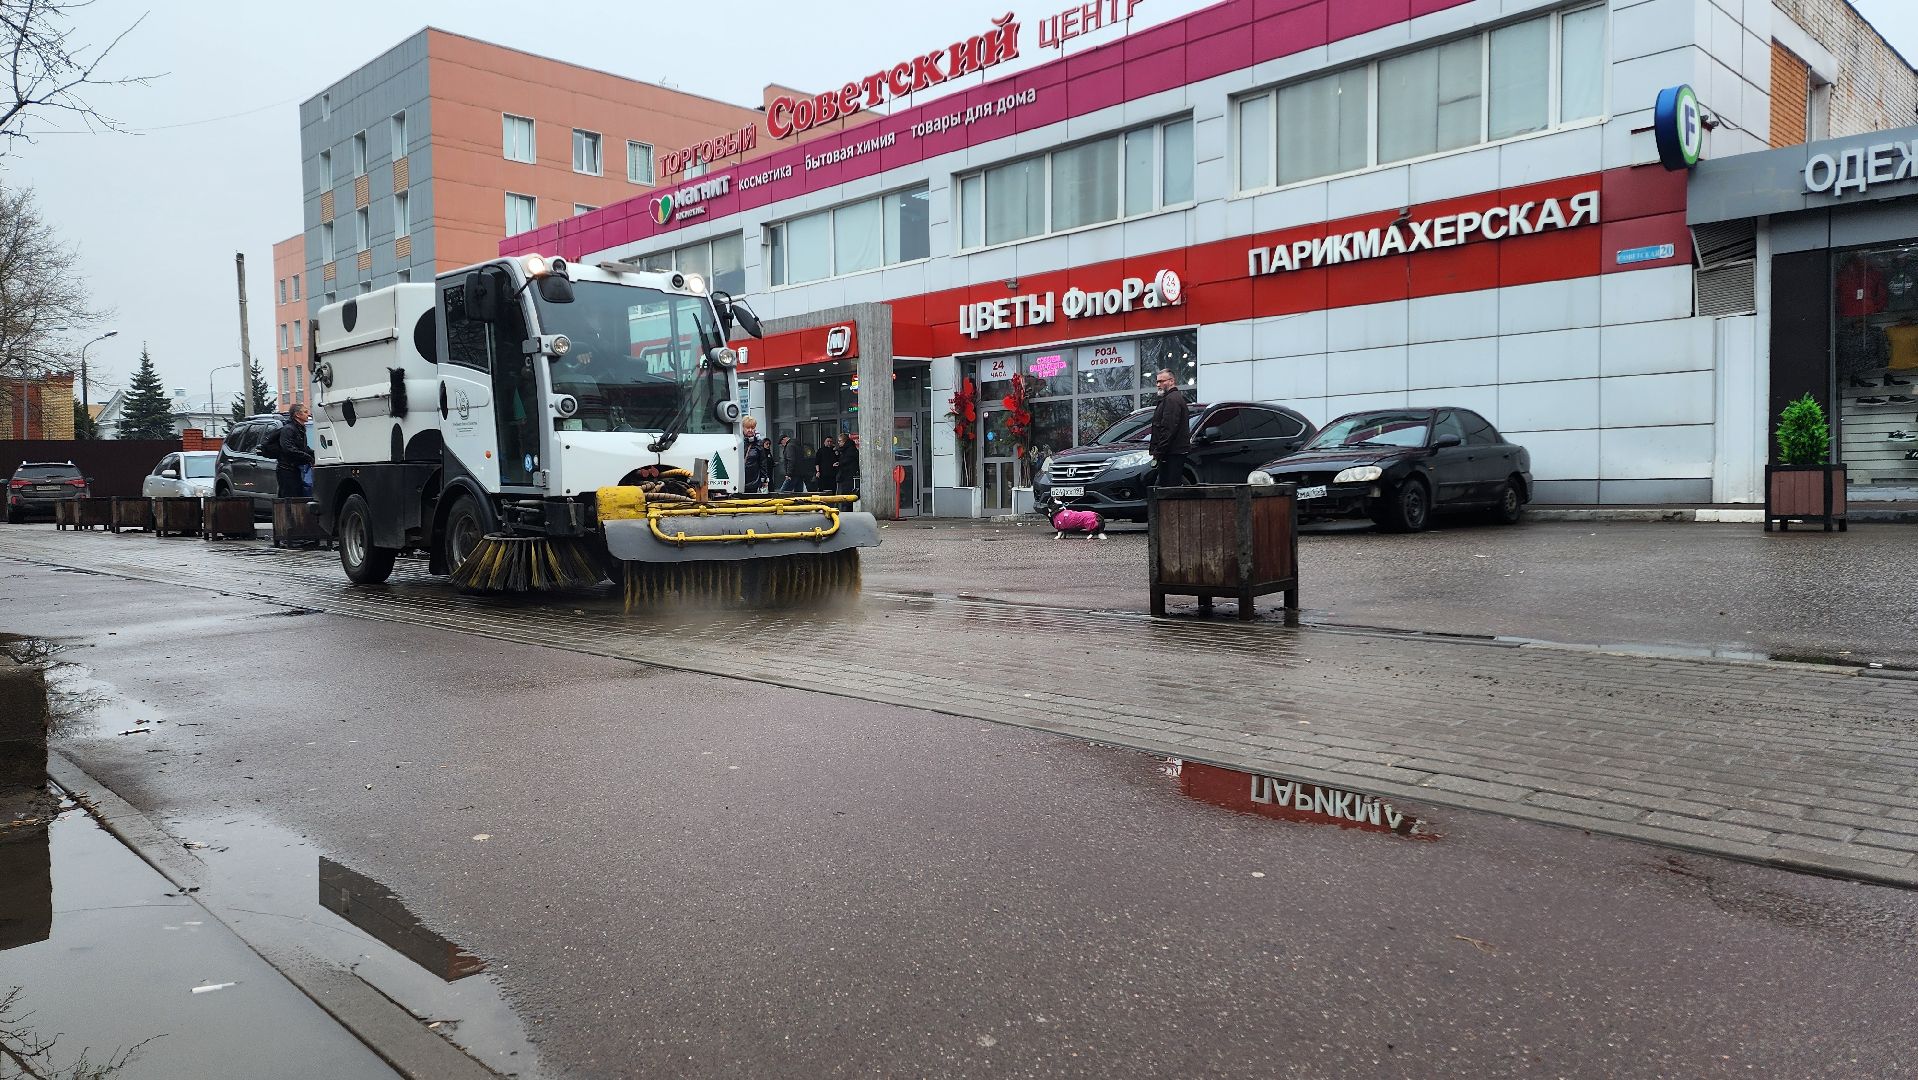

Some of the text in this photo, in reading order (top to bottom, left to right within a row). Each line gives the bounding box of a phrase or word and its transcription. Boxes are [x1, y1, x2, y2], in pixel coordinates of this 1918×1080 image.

[659, 122, 756, 178] ТОРГОВЫЙ
[766, 12, 1021, 140] Советский
[738, 88, 1036, 191] косметика бытовая химия товары для дома
[1248, 190, 1600, 276] ПАРИКМАХЕРСКАЯ
[1660, 245, 1673, 257] 20
[959, 277, 1181, 339] ЦВЕТЫ ФлоРа
[992, 360, 1004, 370] 24
[1095, 346, 1117, 357] РОЗА
